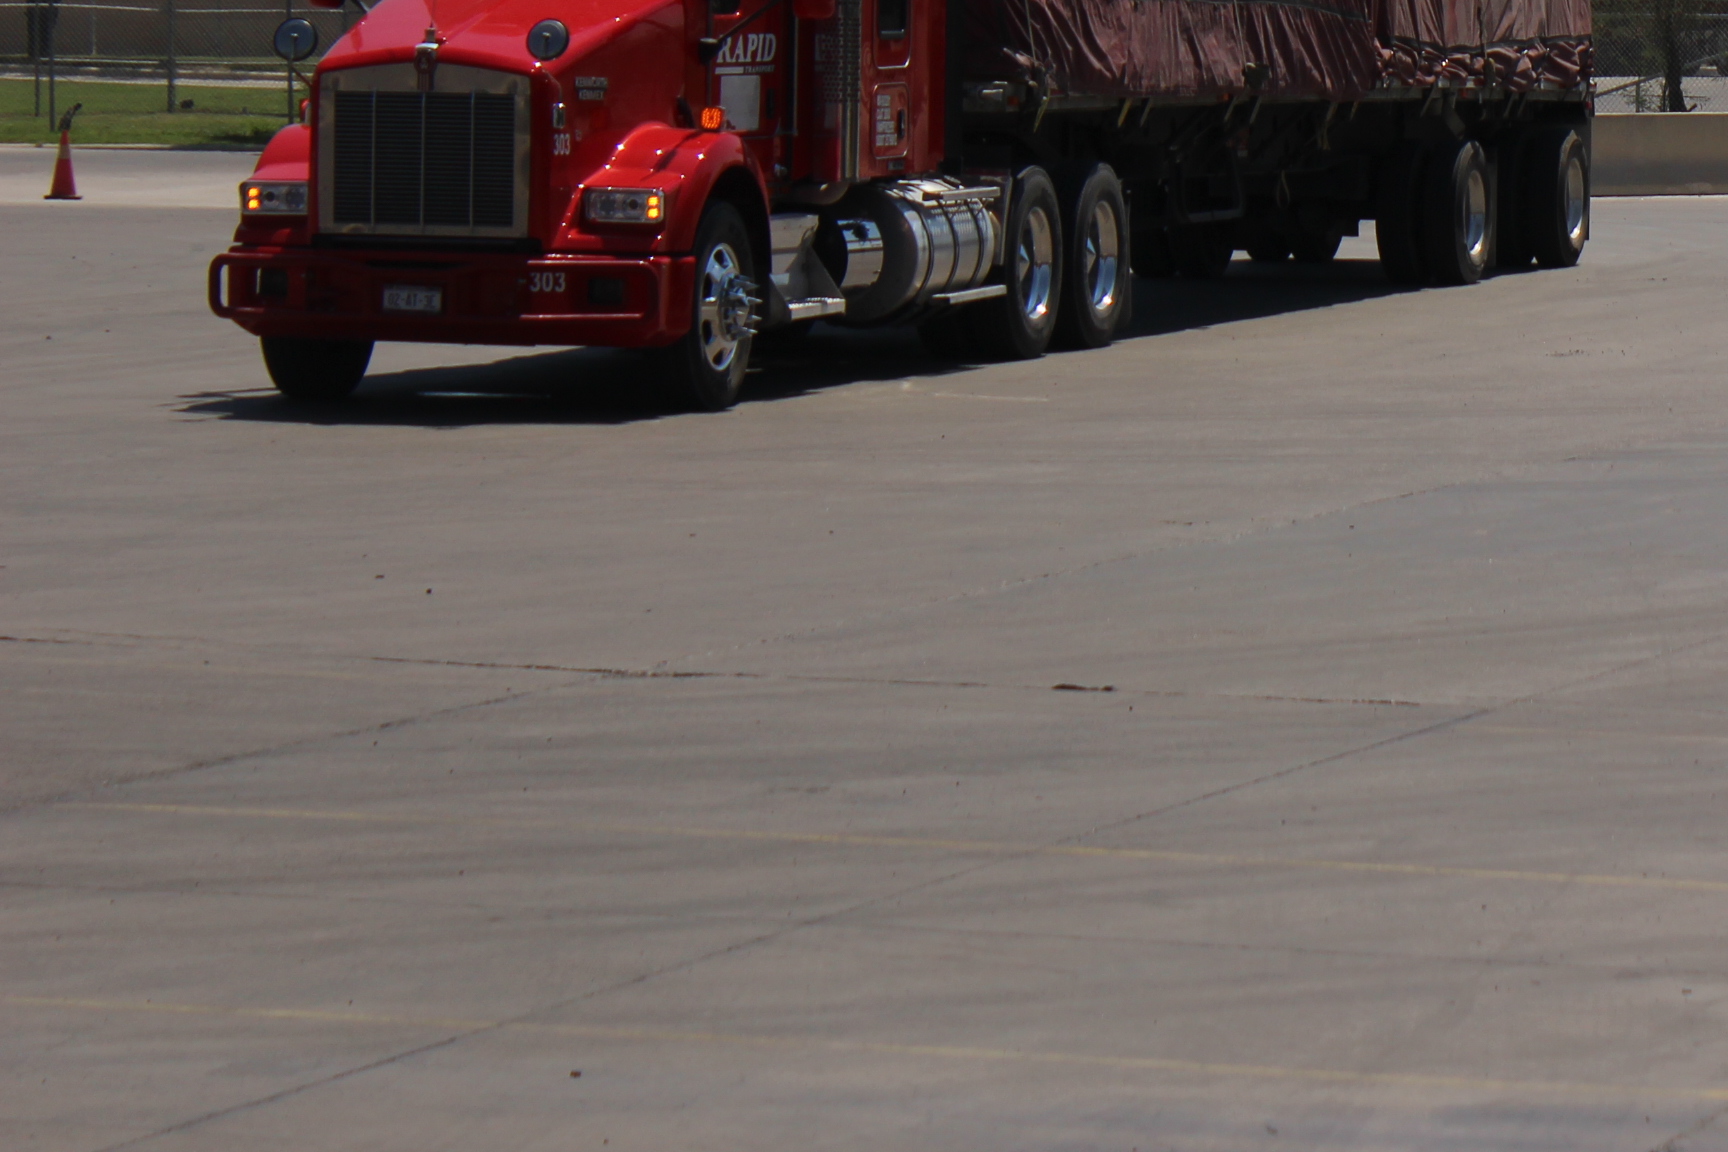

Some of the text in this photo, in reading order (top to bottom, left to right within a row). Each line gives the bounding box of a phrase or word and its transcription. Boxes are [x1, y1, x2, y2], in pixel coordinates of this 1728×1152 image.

[716, 33, 777, 63] RAPID
[554, 133, 570, 155] 303
[529, 272, 566, 292] 303
